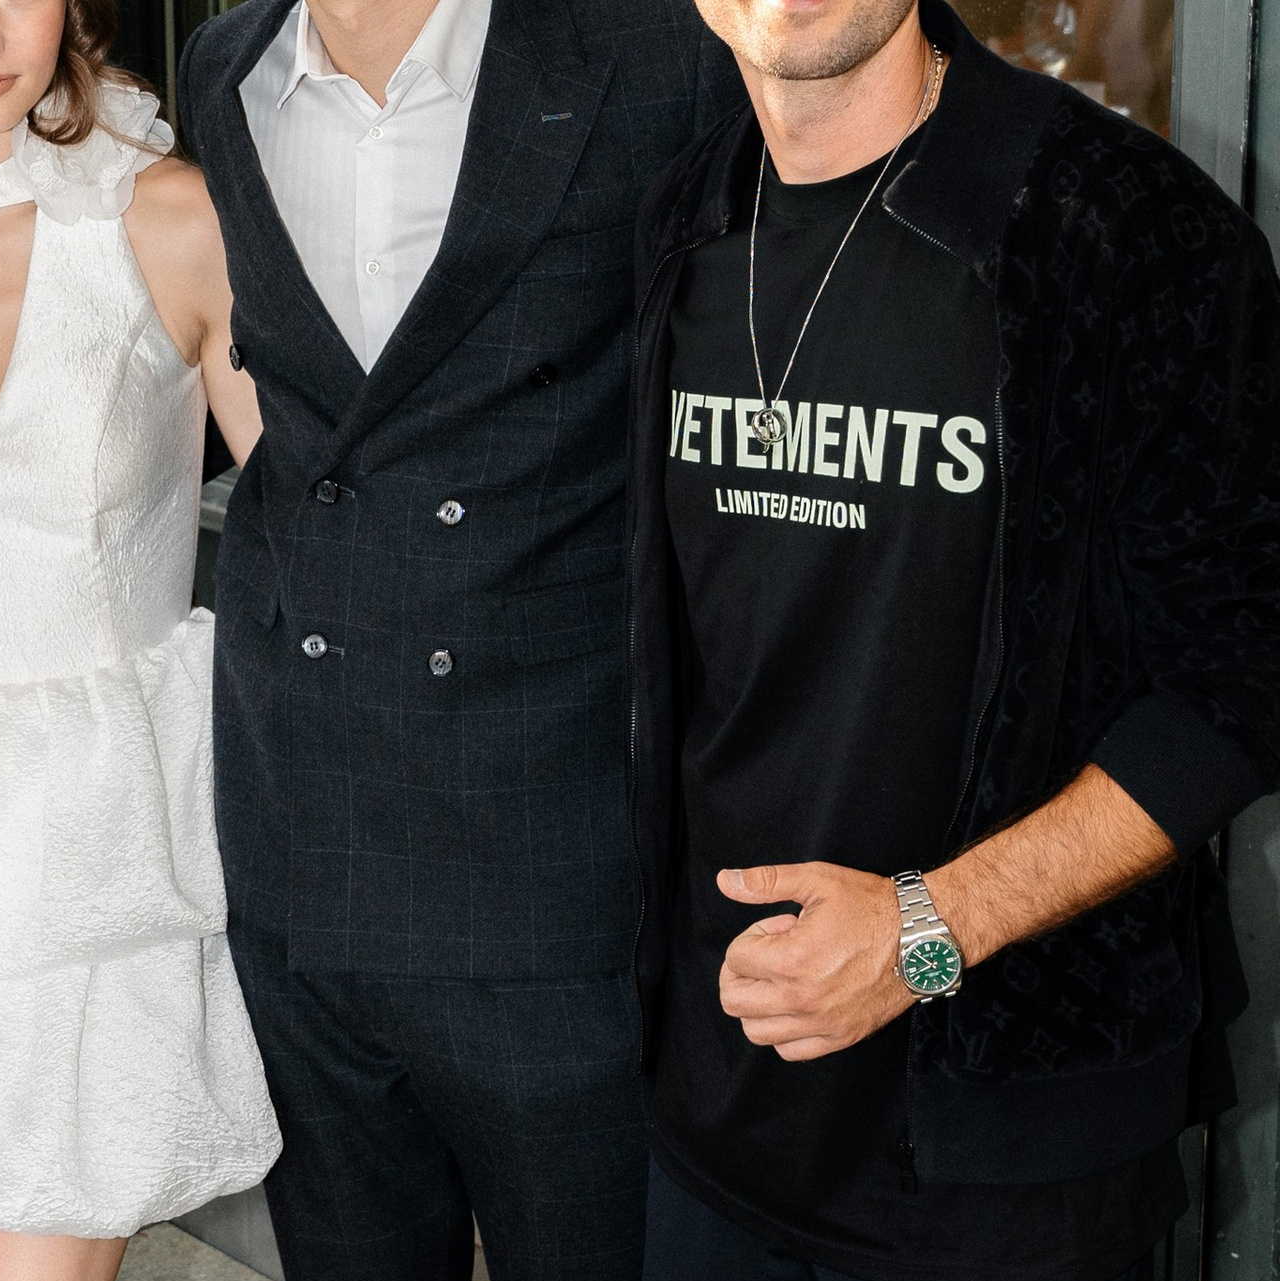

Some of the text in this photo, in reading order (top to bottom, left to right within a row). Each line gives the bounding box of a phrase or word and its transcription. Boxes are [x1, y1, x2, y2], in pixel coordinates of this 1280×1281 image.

[669, 389, 986, 493] VETEMENTS
[716, 488, 866, 530] LIMITED EDITION
